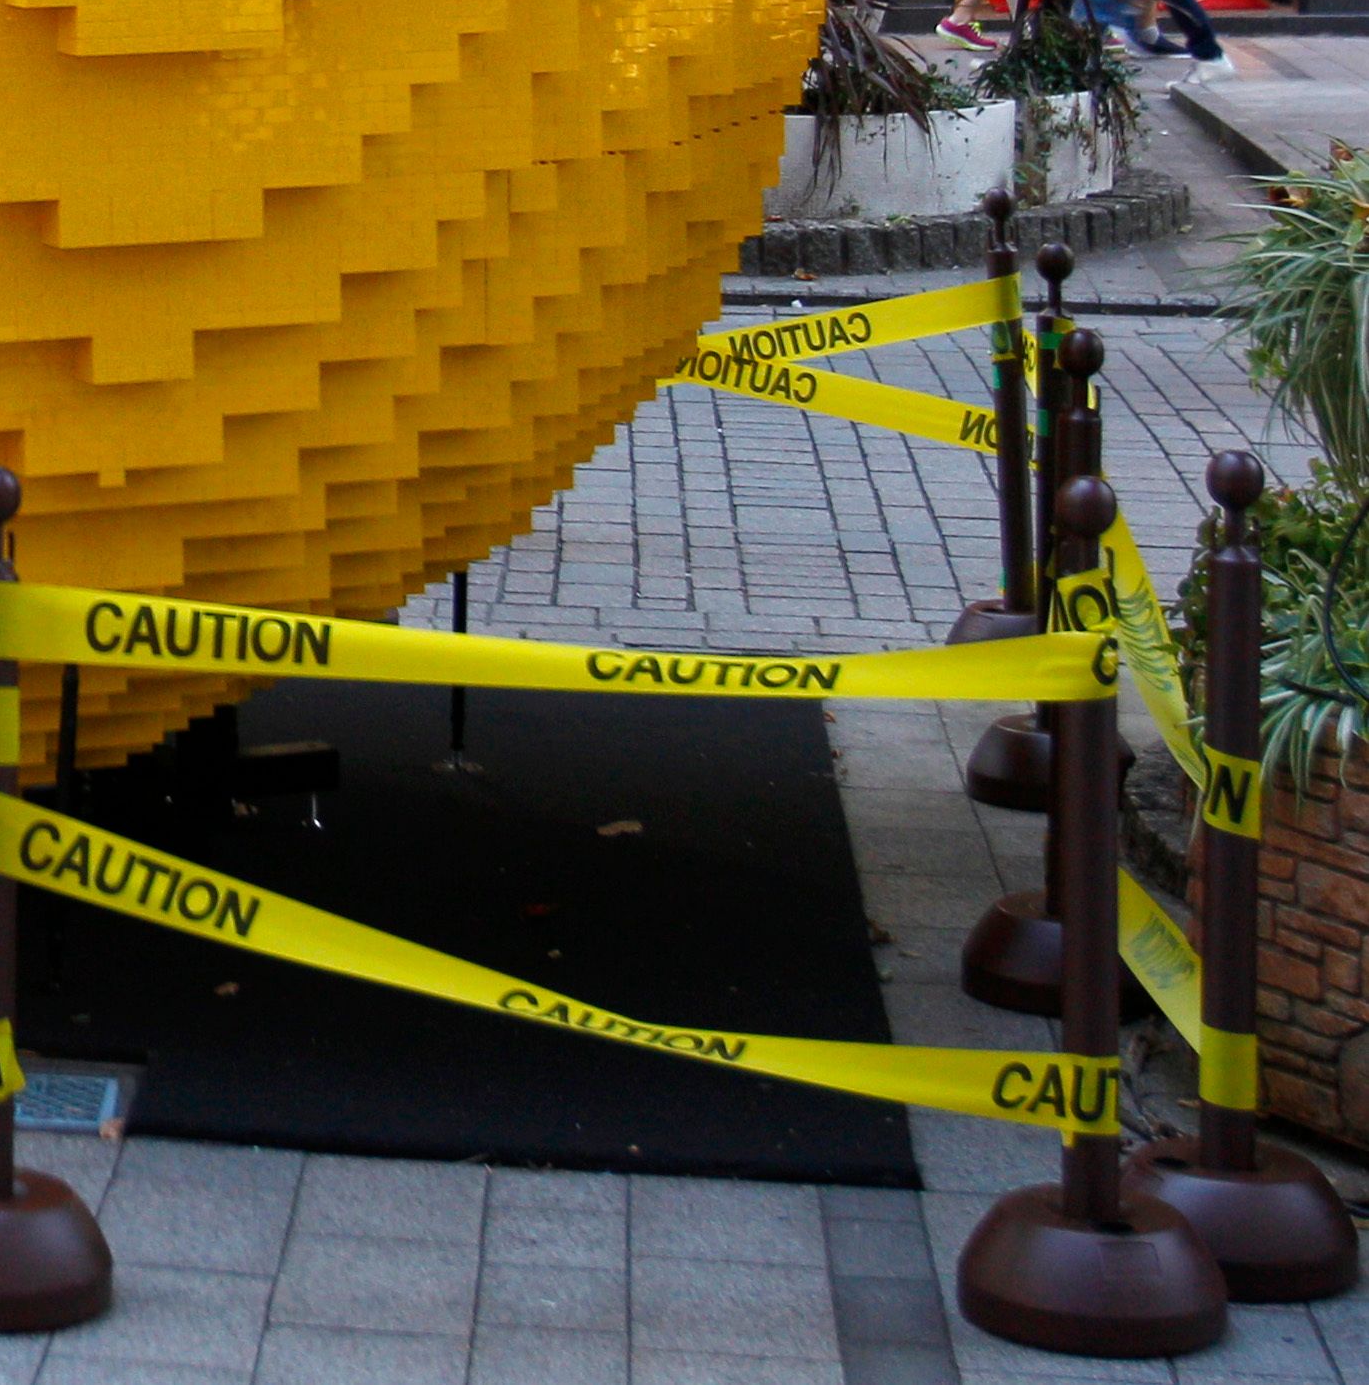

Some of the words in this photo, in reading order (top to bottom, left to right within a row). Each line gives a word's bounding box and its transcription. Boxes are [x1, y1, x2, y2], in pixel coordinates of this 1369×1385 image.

[84, 601, 332, 666] CAUTION
[586, 649, 841, 690] CAUTION
[19, 820, 260, 938] CAUTION
[497, 988, 747, 1061] CAUTION
